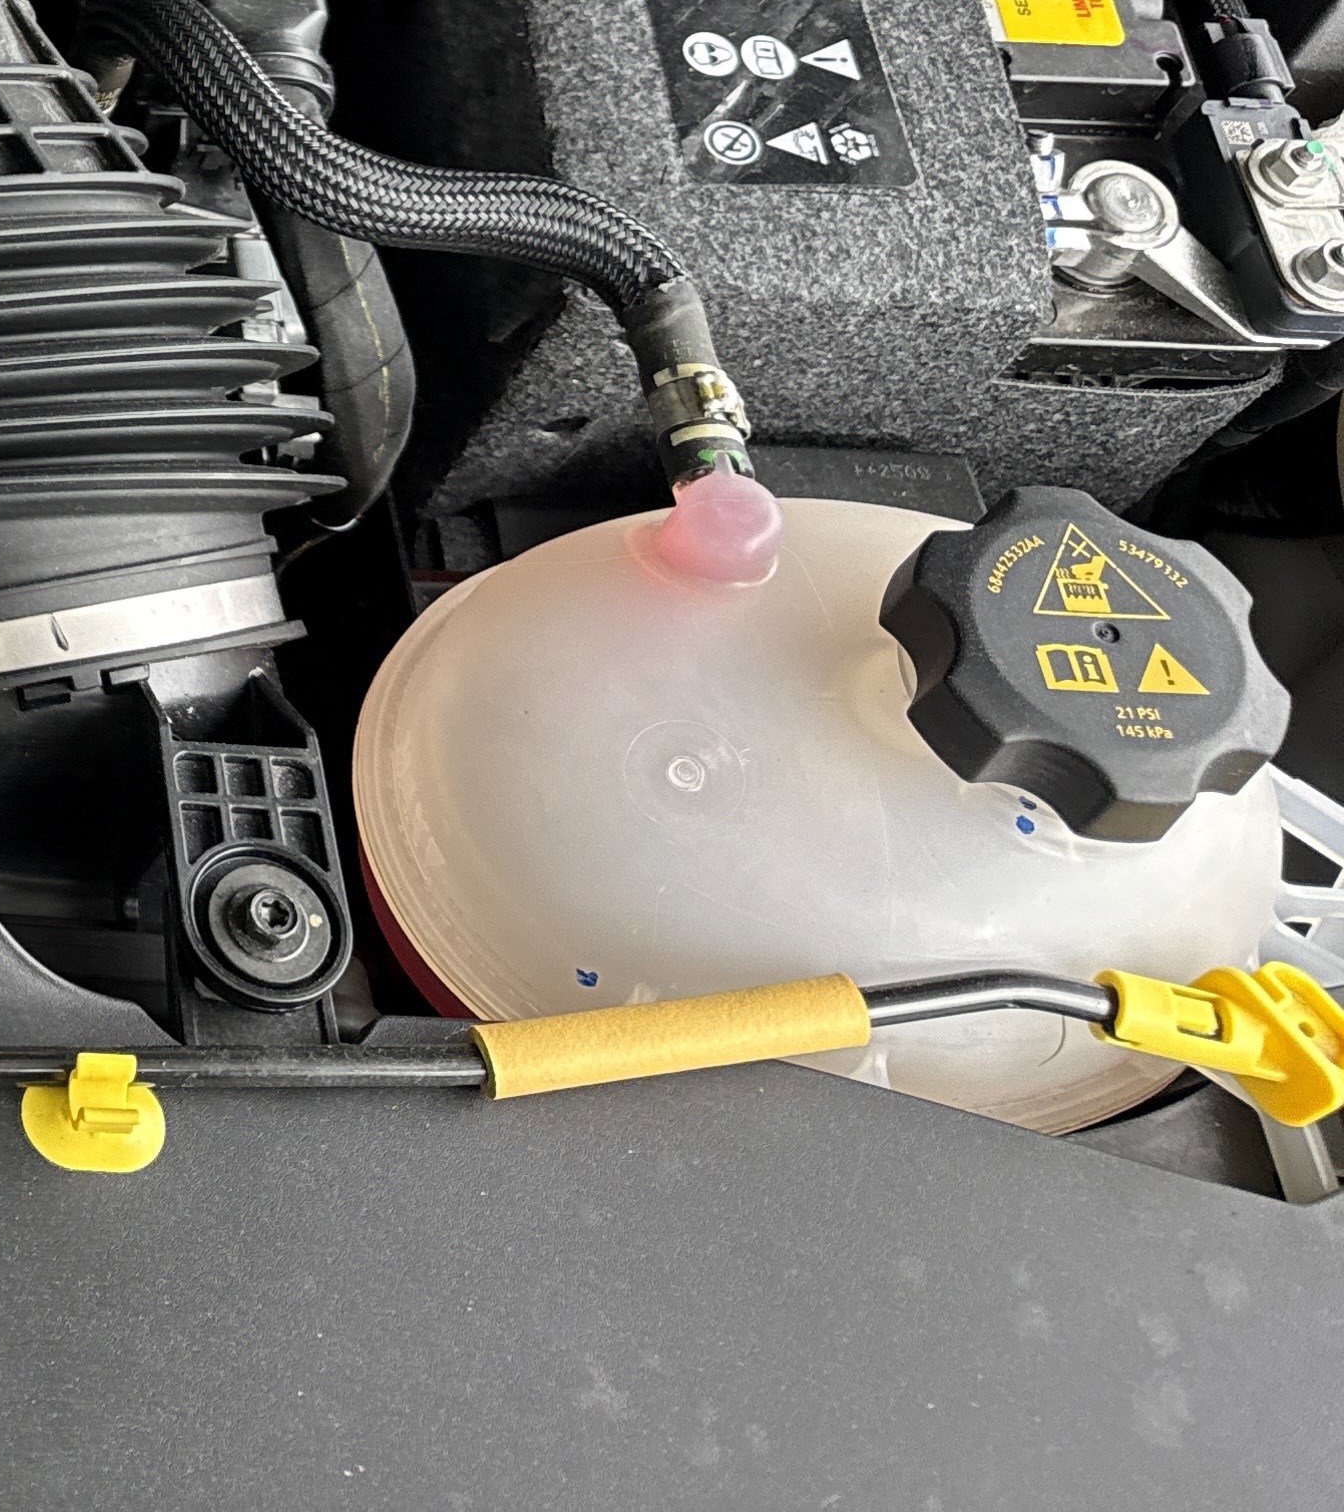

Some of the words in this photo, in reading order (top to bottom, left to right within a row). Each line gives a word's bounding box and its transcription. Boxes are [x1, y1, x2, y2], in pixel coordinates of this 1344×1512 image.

[1115, 706, 1135, 719] 21
[1138, 708, 1160, 720] PSI
[1115, 724, 1144, 737] 145
[1147, 725, 1174, 739] kPa
